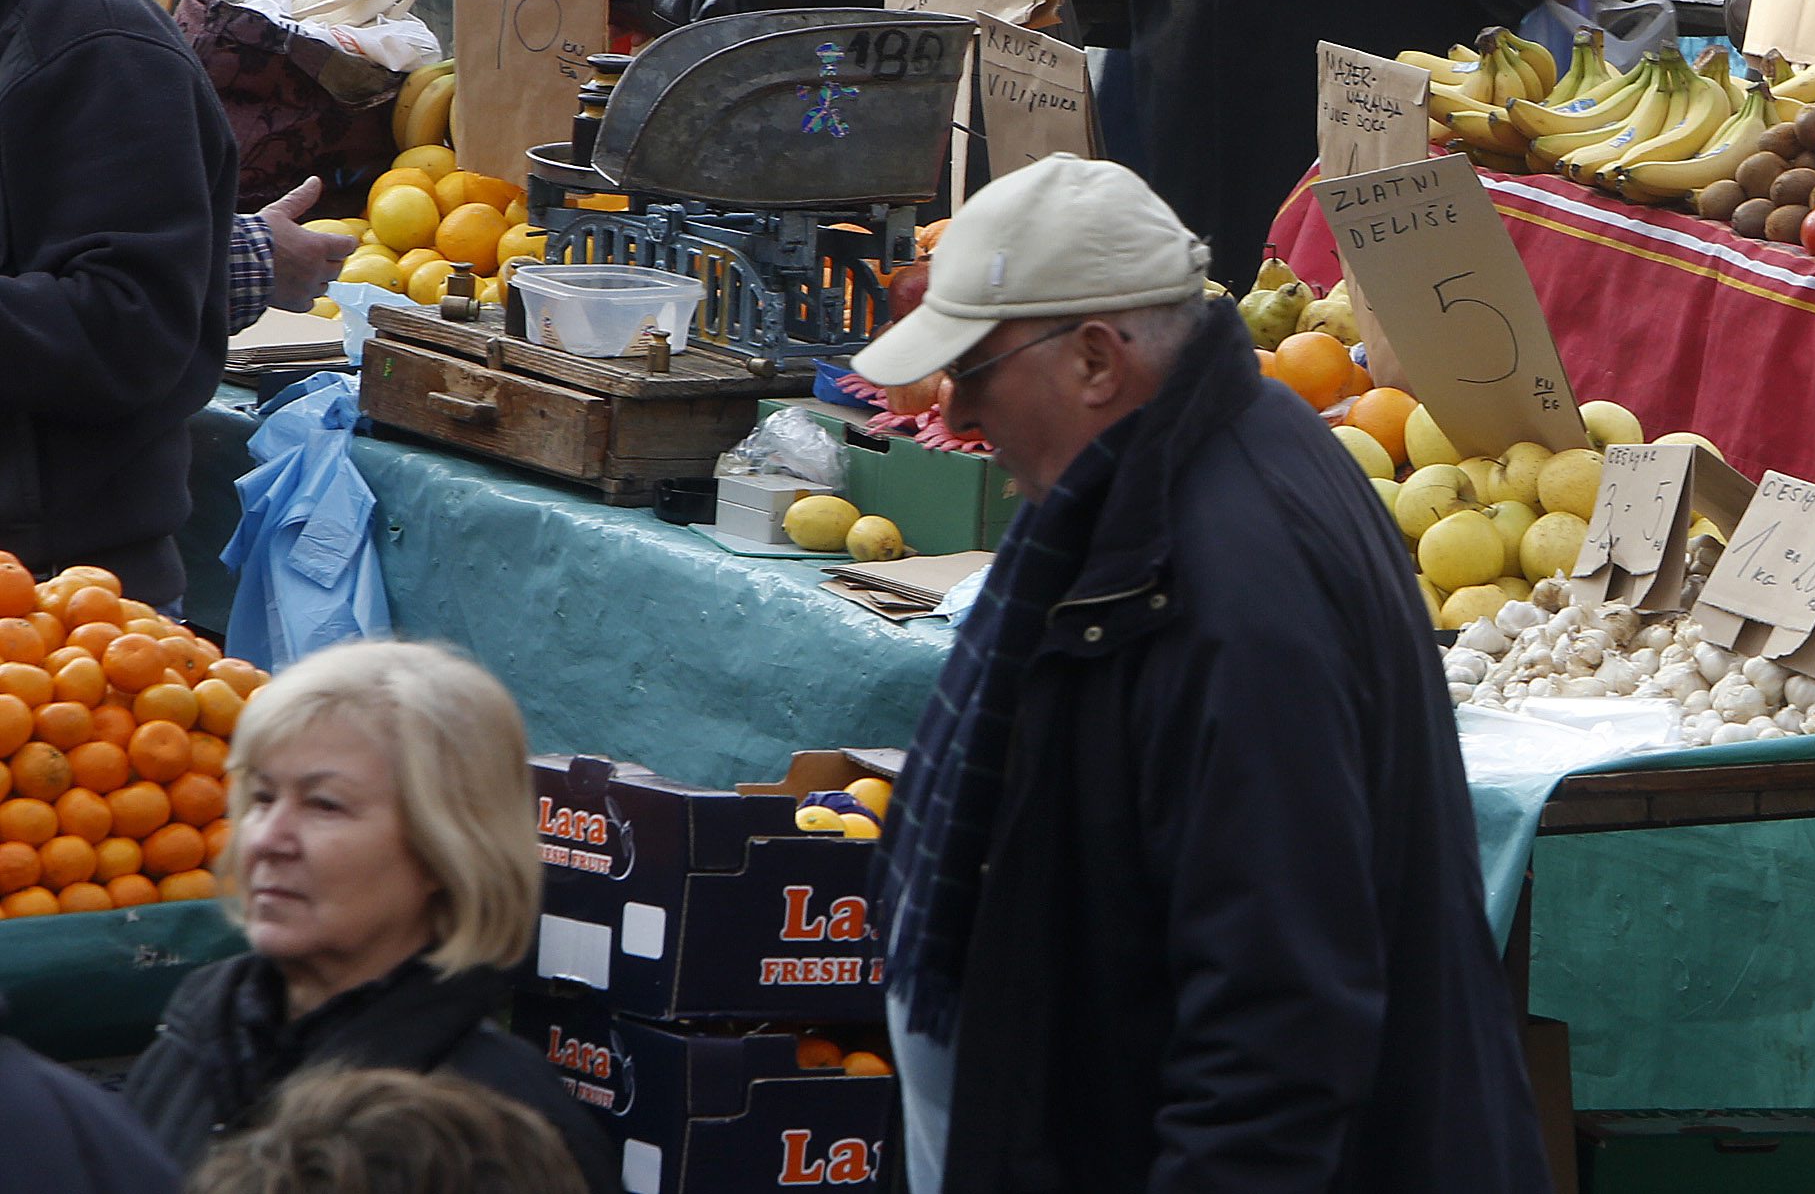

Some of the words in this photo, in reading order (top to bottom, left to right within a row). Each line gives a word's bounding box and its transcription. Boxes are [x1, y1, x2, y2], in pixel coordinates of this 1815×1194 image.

[1330, 170, 1440, 212] ZLATNI
[1433, 271, 1519, 384] 5
[1642, 481, 1673, 541] 5
[1732, 520, 1781, 578] 1
[1750, 566, 1777, 586] KG
[537, 796, 607, 845] Lara
[537, 843, 569, 866] RESH
[571, 849, 612, 875] FRUIT
[779, 885, 879, 942] La
[760, 957, 861, 986] FRESH
[547, 1025, 610, 1079] Lara
